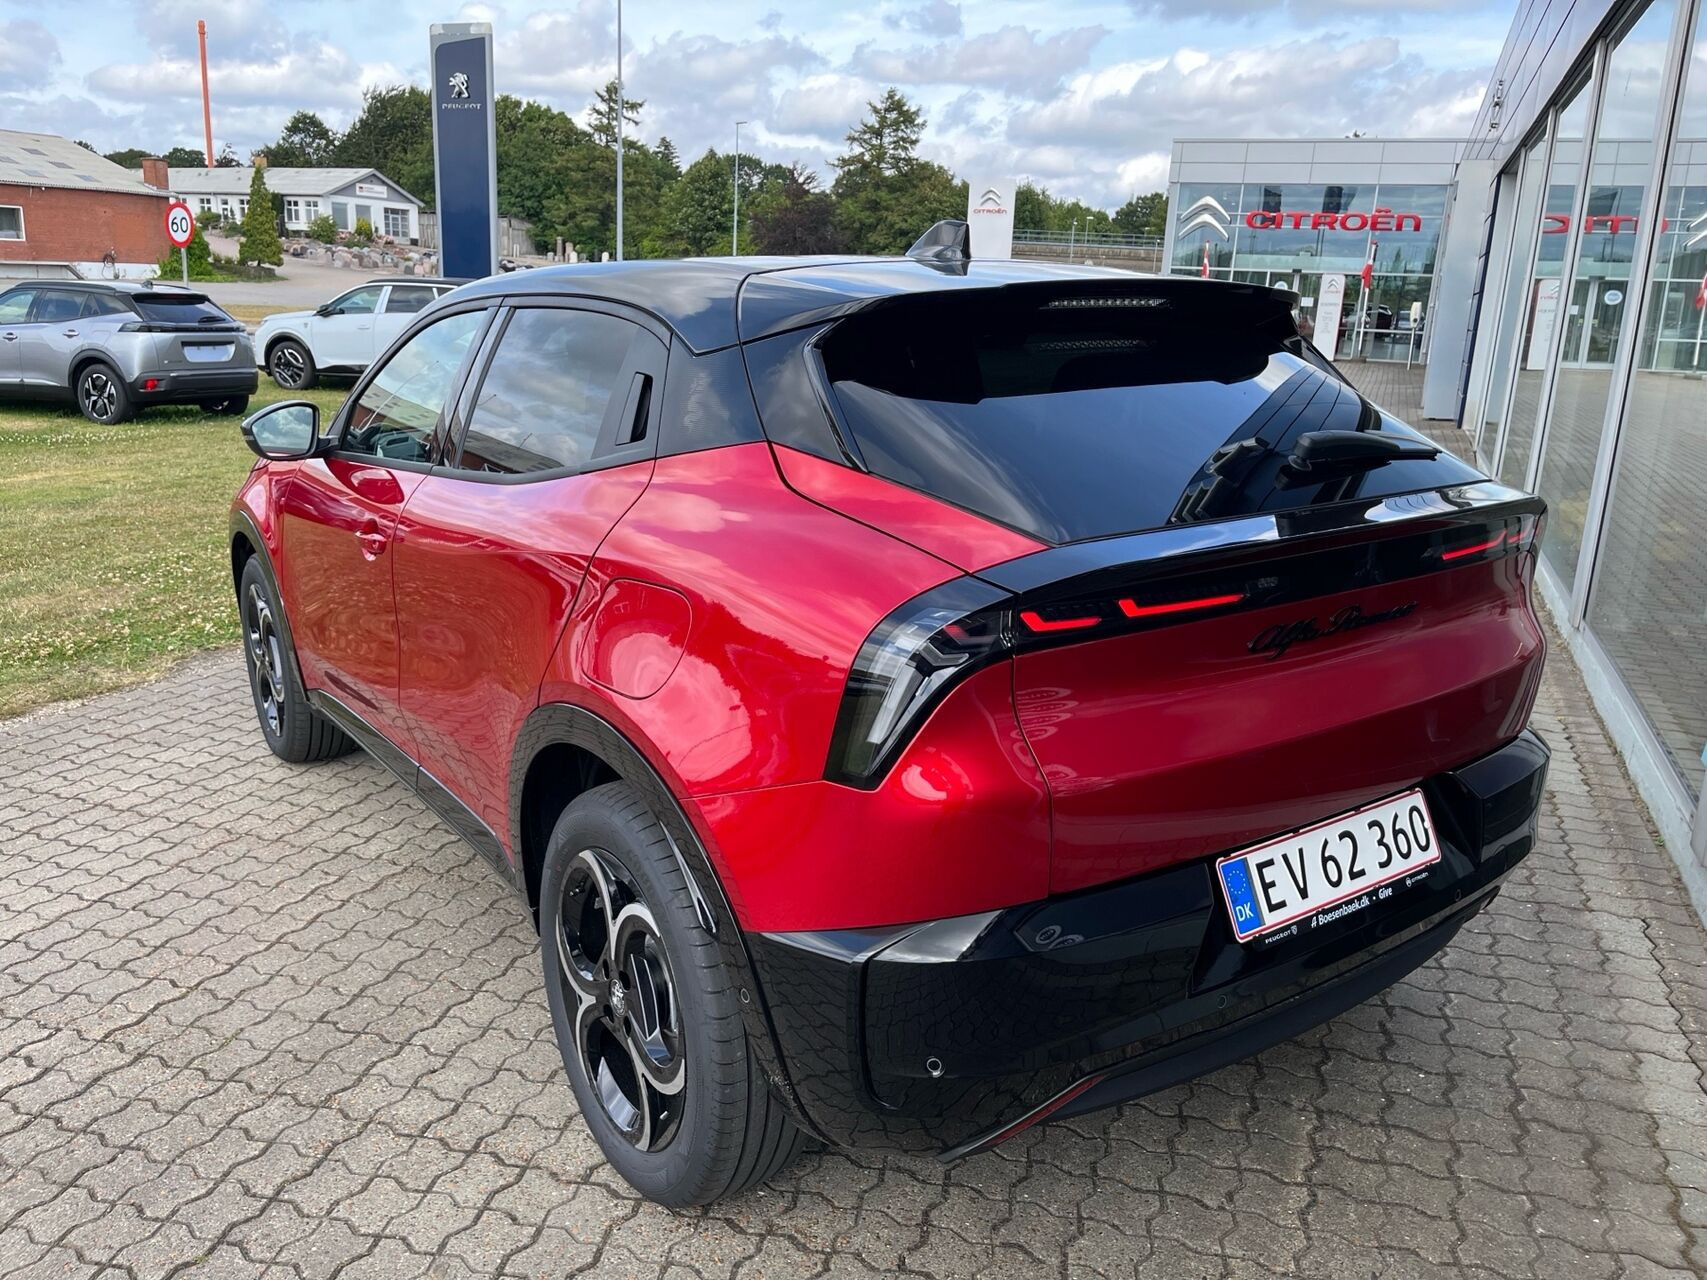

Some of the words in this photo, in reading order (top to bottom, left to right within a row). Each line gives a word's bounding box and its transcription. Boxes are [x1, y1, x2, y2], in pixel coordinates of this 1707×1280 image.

[171, 216, 188, 233] 60
[1247, 616, 1318, 661] Alfa
[1255, 847, 1309, 913] EV
[1320, 830, 1367, 888] 62
[1367, 805, 1431, 869] 360
[1235, 902, 1254, 922] DK
[1318, 896, 1370, 925] Boesenbaek.dk
[1378, 886, 1393, 900] Give
[1265, 930, 1291, 944] PEUGEOT
